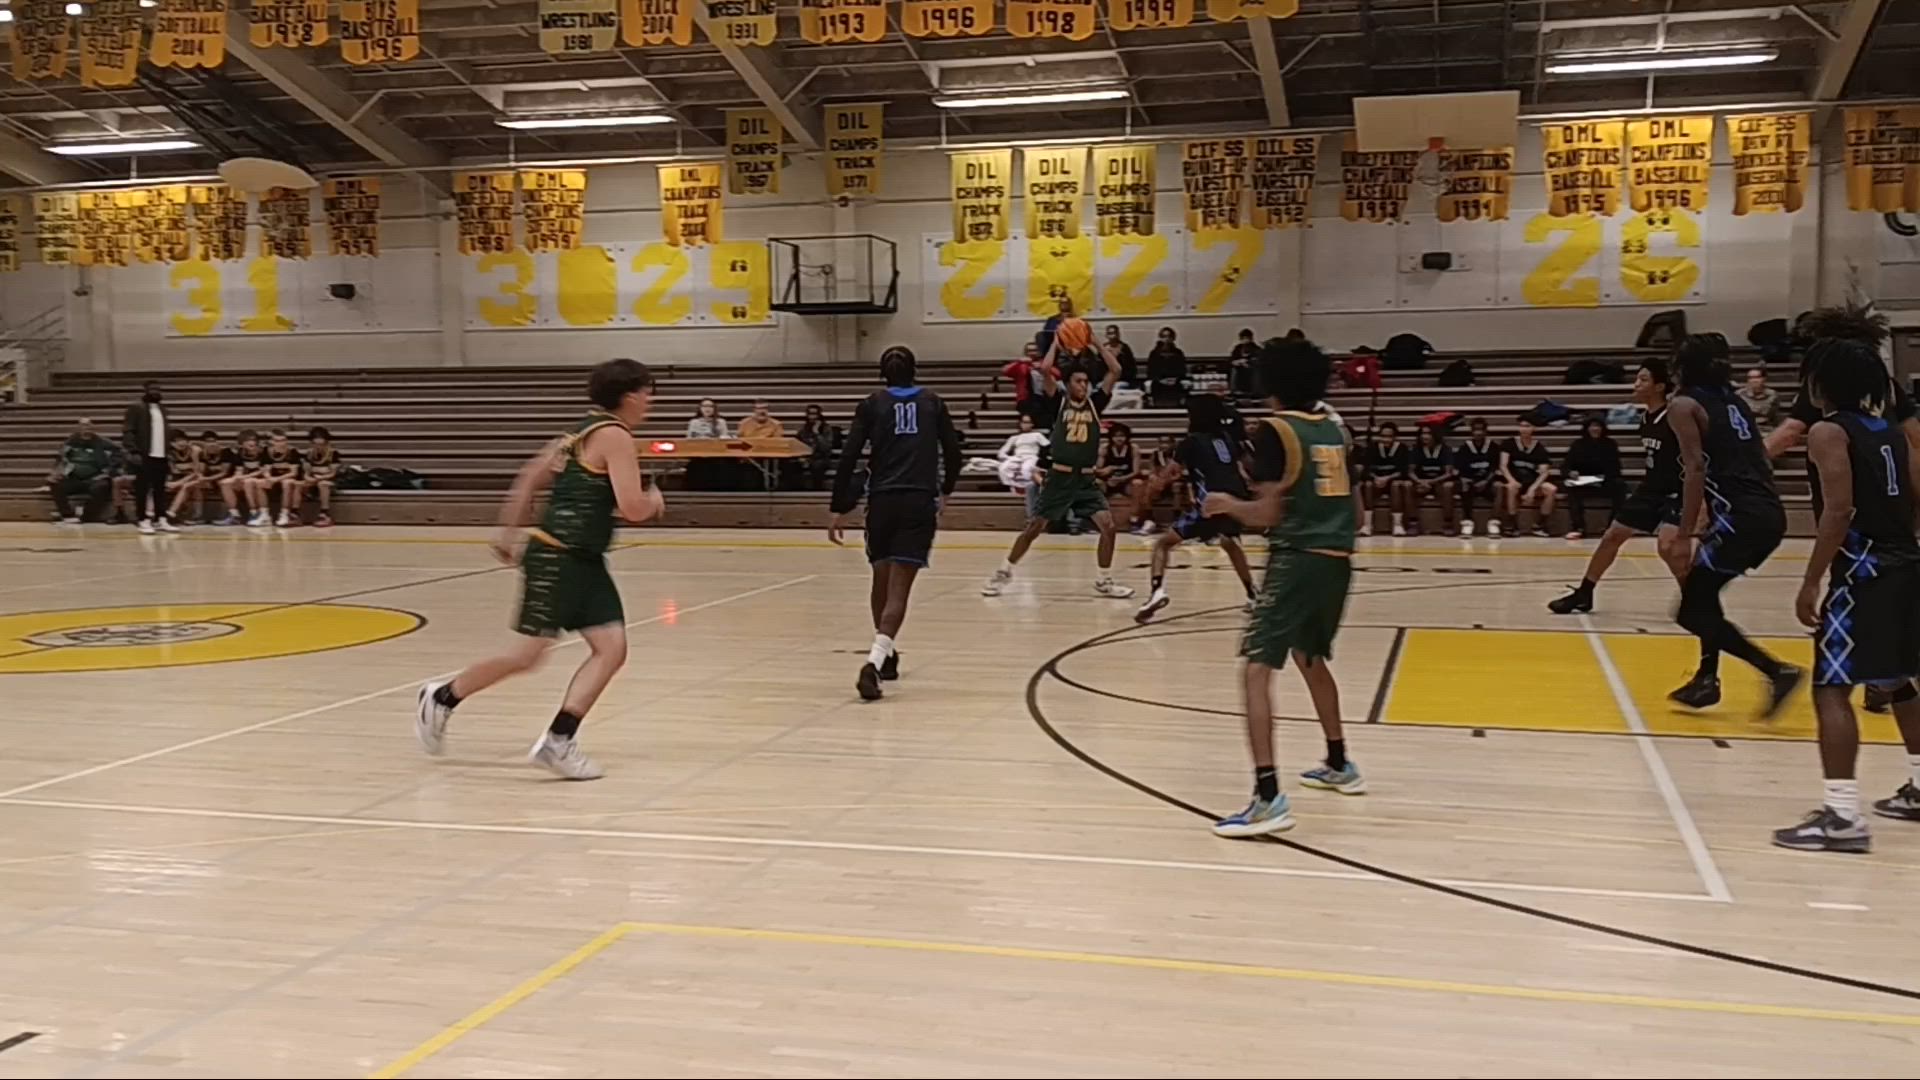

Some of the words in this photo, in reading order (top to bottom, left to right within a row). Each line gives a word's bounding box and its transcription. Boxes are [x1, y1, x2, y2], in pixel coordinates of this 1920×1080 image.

[540, 12, 617, 29] WRESTLING
[921, 6, 974, 31] 1996
[731, 142, 778, 156] CHAMPS
[829, 137, 879, 151] CHAMPS
[956, 186, 1004, 200] CHAMPS
[1029, 181, 1079, 196] CHAMPS
[1100, 183, 1150, 198] CHAMPS
[962, 204, 1002, 218] TRACK
[1034, 201, 1072, 214] TRACK
[1521, 210, 1700, 307] 26
[1100, 229, 1266, 315] 27
[631, 241, 768, 325] 29
[168, 256, 297, 336] 31
[893, 402, 919, 434] 11
[1727, 404, 1751, 440] 4
[1065, 423, 1089, 442] 20
[1879, 444, 1900, 496] 1
